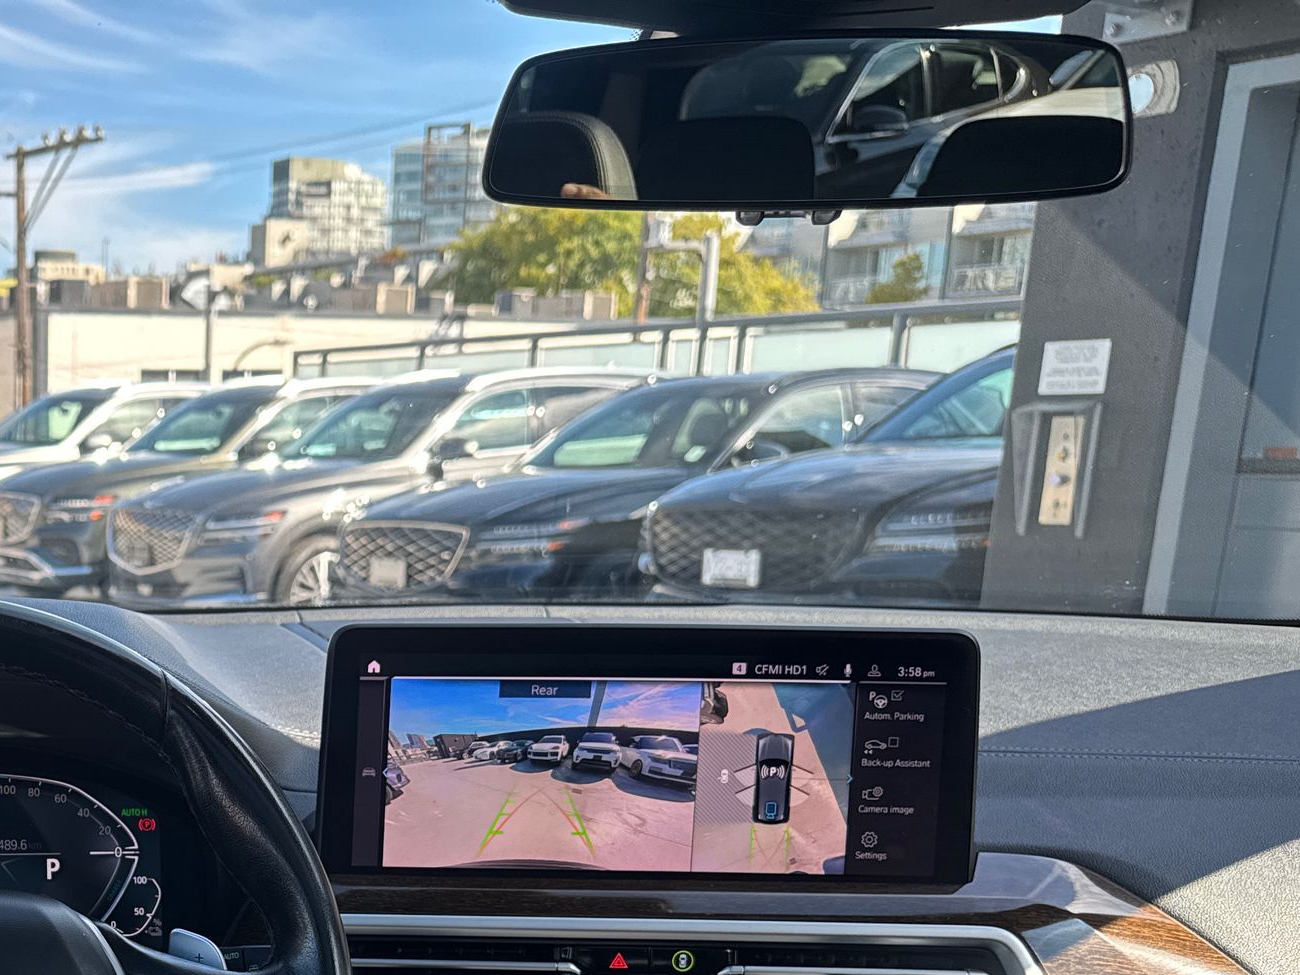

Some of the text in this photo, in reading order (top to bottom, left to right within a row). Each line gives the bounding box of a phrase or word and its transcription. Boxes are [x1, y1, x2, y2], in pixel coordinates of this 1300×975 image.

[755, 665, 782, 675] CFMI
[785, 665, 807, 675] HD1
[897, 666, 935, 678] 3:58 pm
[531, 685, 559, 696] Rear
[864, 712, 924, 722] Autom. Parking
[861, 758, 930, 770] Back-up Assistant
[0, 785, 16, 795] 100
[28, 787, 40, 797] 80
[54, 794, 66, 803] 60
[77, 808, 90, 818] 40
[121, 808, 148, 817] AUTO H
[858, 805, 914, 816] Camera image
[99, 825, 112, 836] 20
[114, 847, 122, 858] 0
[855, 851, 887, 861] Settings
[46, 858, 61, 880] P
[133, 876, 148, 885] 100
[134, 907, 145, 916] 50
[110, 920, 117, 929] 0
